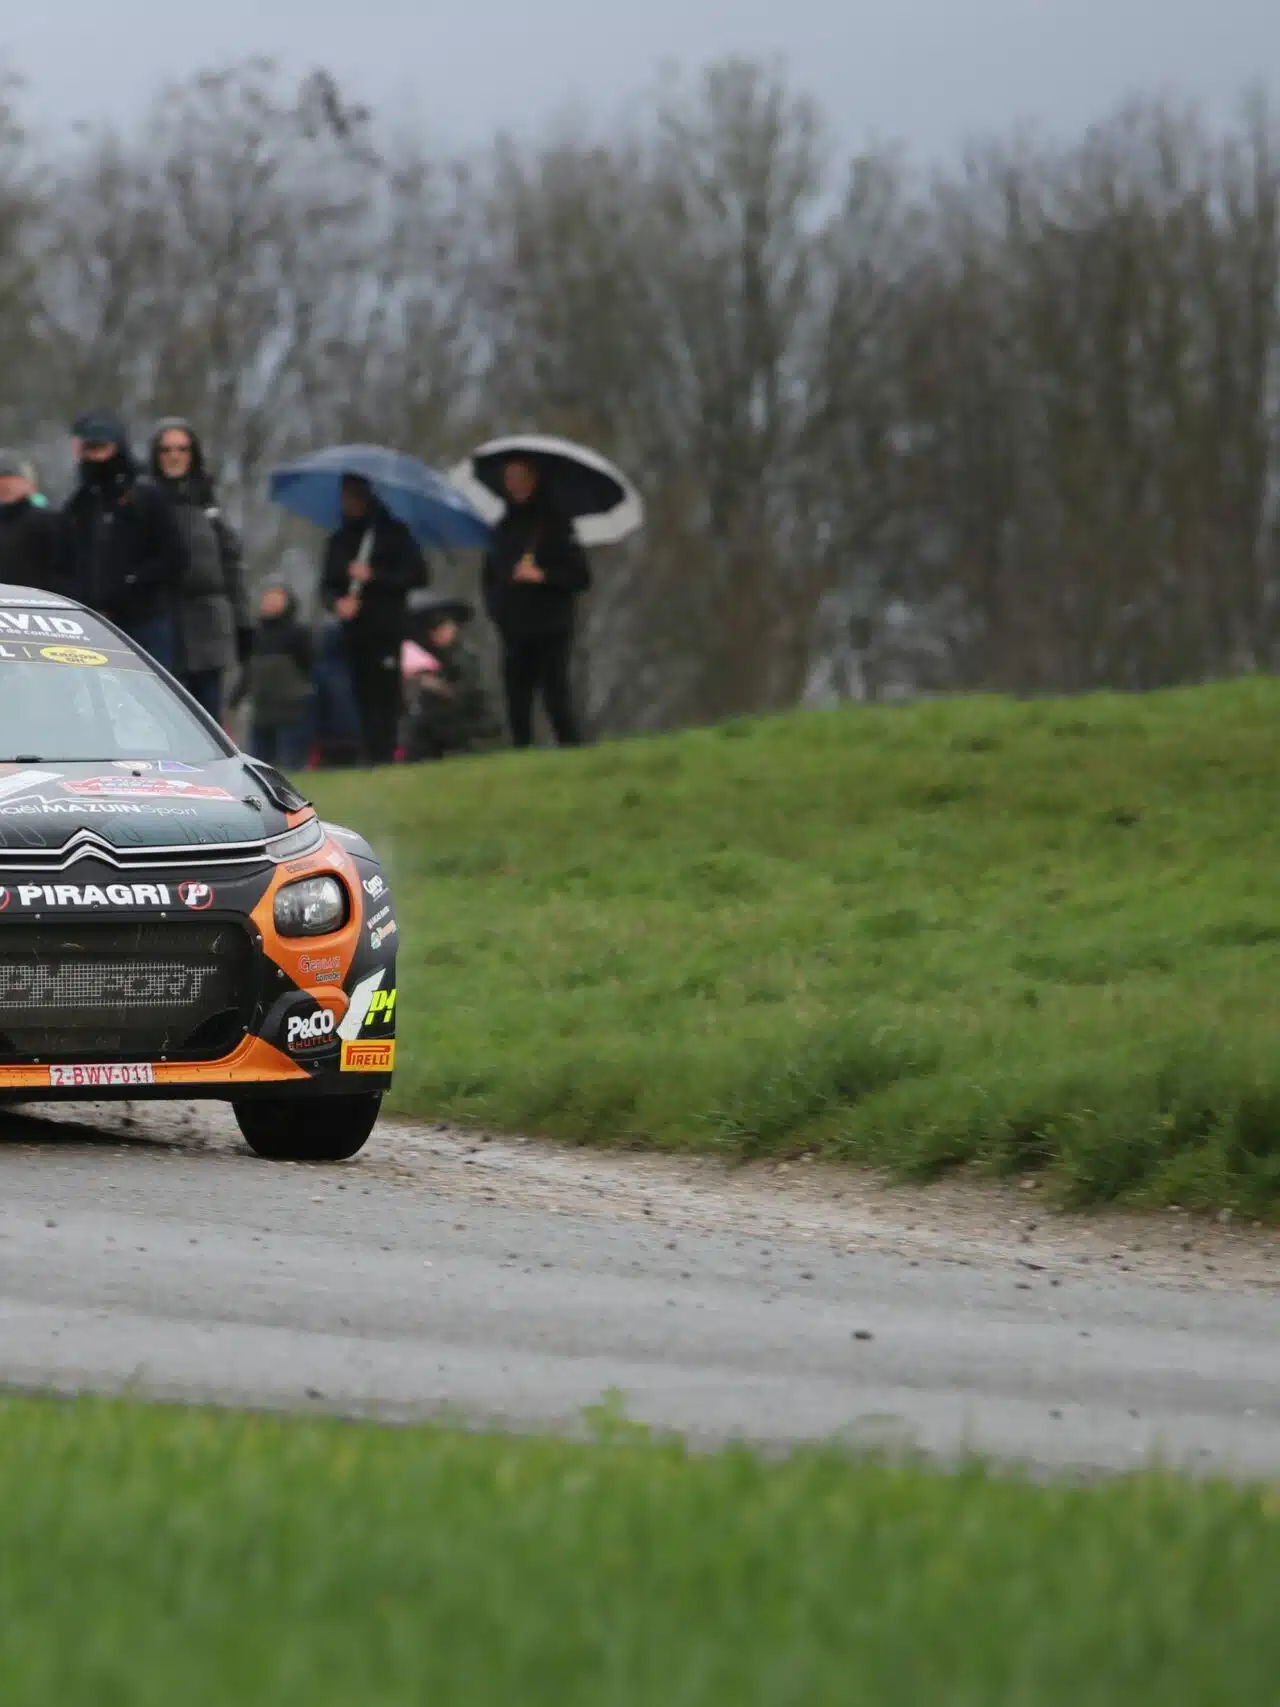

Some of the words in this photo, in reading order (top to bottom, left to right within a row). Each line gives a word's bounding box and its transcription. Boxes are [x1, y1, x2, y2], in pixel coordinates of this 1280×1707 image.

[17, 884, 171, 906] PIRAGRI
[288, 1009, 334, 1042] P&CO
[346, 1045, 391, 1066] PIRELLI
[55, 1065, 149, 1086] 2-BWV-011
